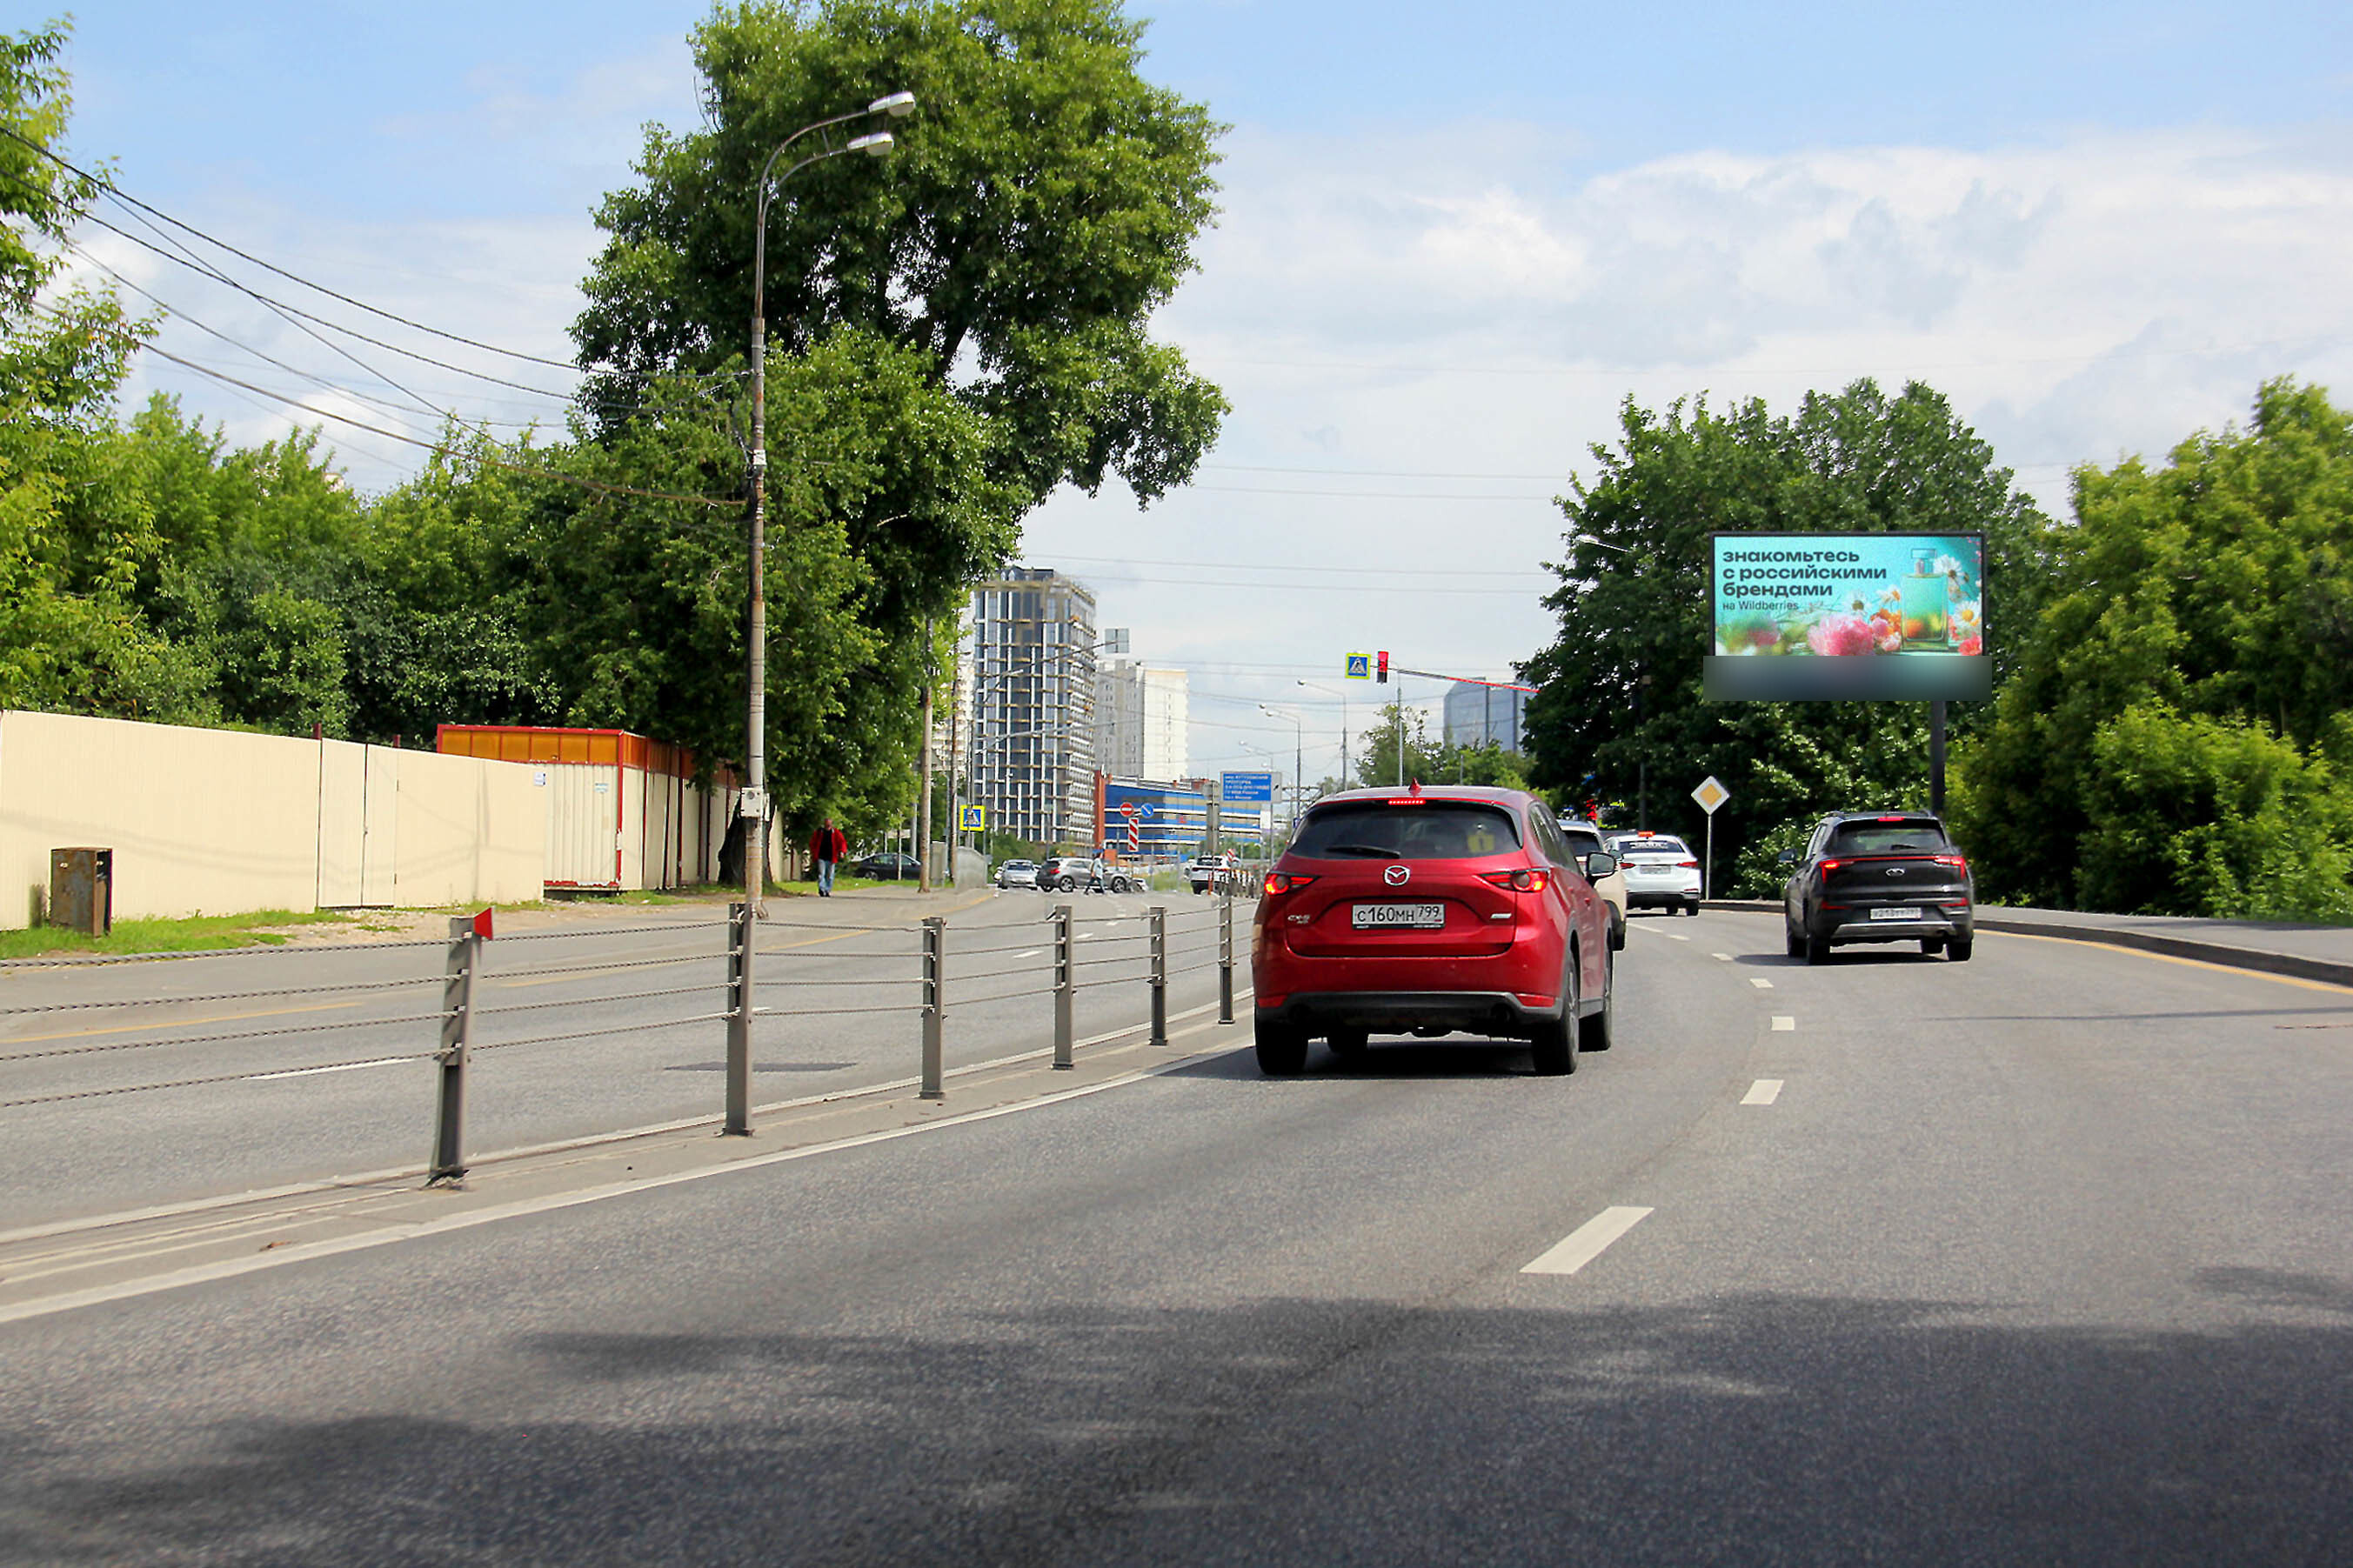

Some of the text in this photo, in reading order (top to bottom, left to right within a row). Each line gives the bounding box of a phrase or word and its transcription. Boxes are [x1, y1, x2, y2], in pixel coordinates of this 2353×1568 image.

[1722, 550, 1860, 563] знакомьтесь
[1722, 564, 1887, 582] с российскими
[1722, 582, 1833, 598] брендами
[1722, 600, 1799, 611] на Wildberries
